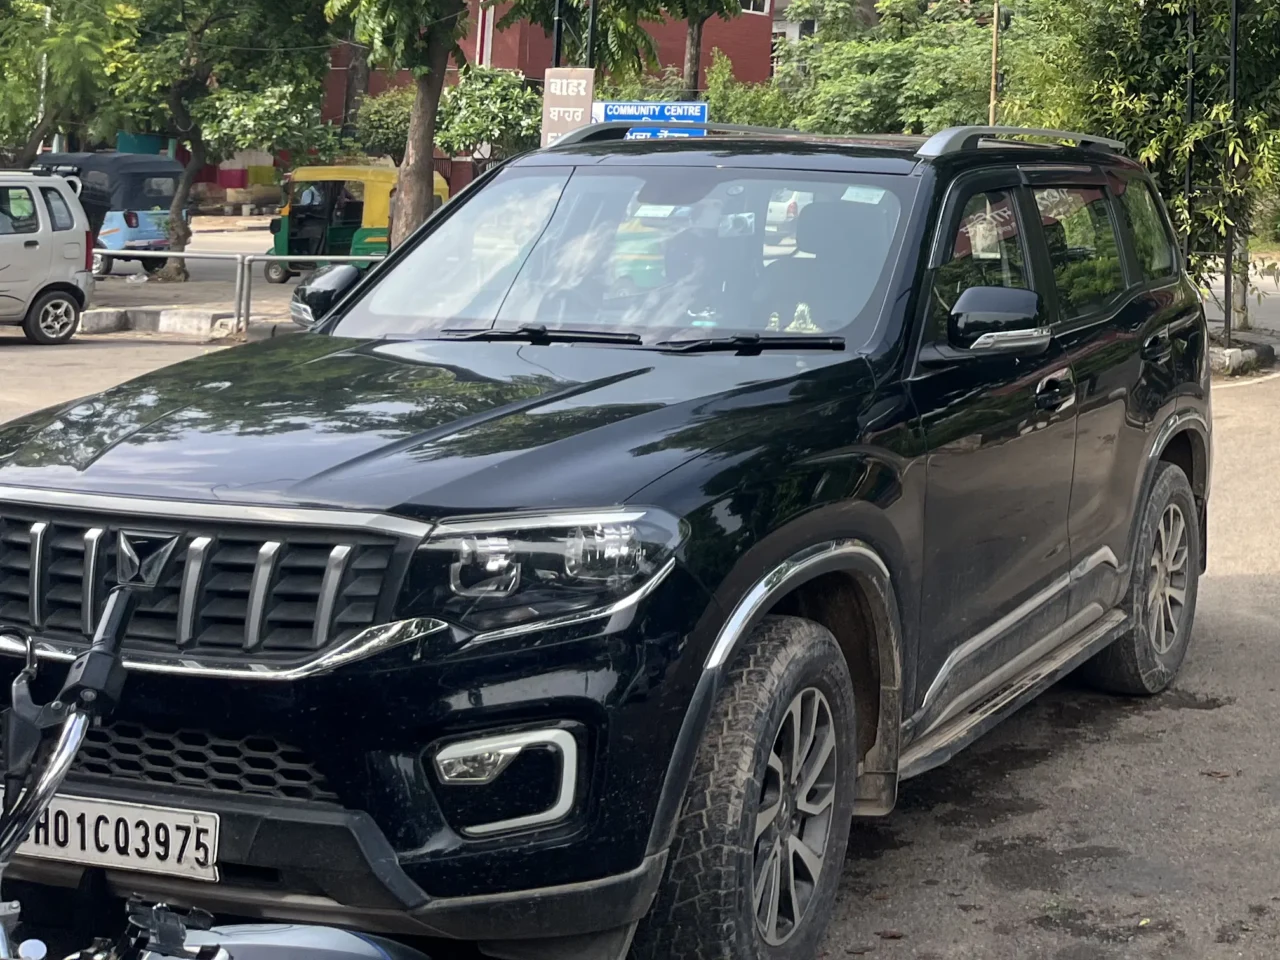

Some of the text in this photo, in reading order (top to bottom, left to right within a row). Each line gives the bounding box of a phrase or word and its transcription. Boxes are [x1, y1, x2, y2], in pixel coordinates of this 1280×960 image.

[550, 78, 587, 96] बाहर
[549, 107, 584, 122] ਬਾਹਰ
[606, 105, 701, 116] COMMUNITY CENTRE
[22, 806, 210, 867] H01CQ3975
